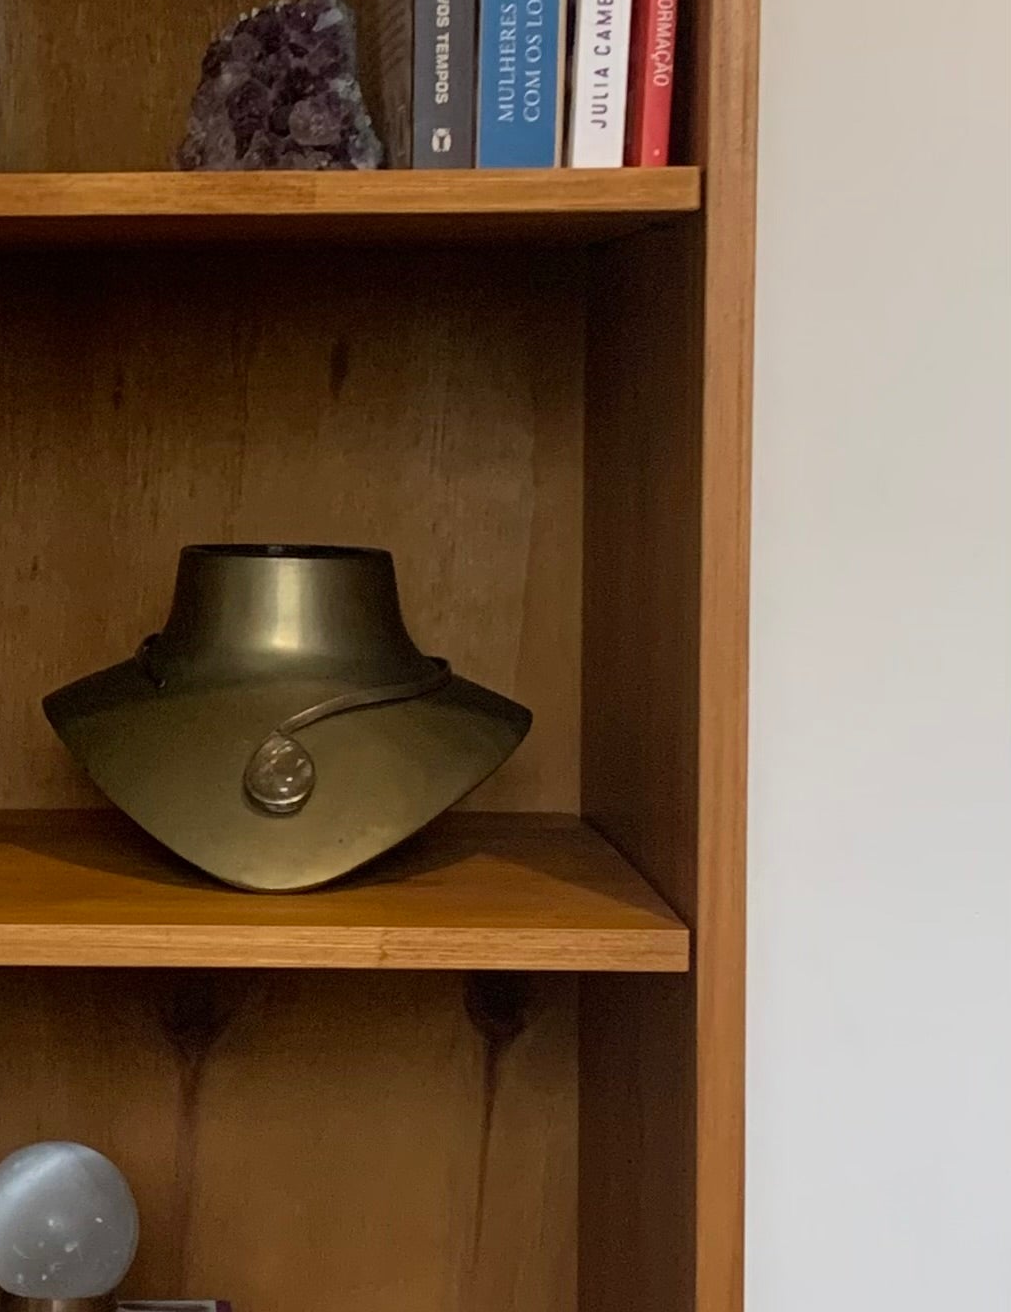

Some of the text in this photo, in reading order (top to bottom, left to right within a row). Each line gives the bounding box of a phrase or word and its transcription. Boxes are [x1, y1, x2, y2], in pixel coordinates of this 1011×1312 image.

[436, 34, 449, 103] TEMPOS
[498, 4, 516, 121] MULHERES
[526, 35, 541, 62] OS
[524, 71, 541, 121] COM
[591, 68, 609, 128] JULIA
